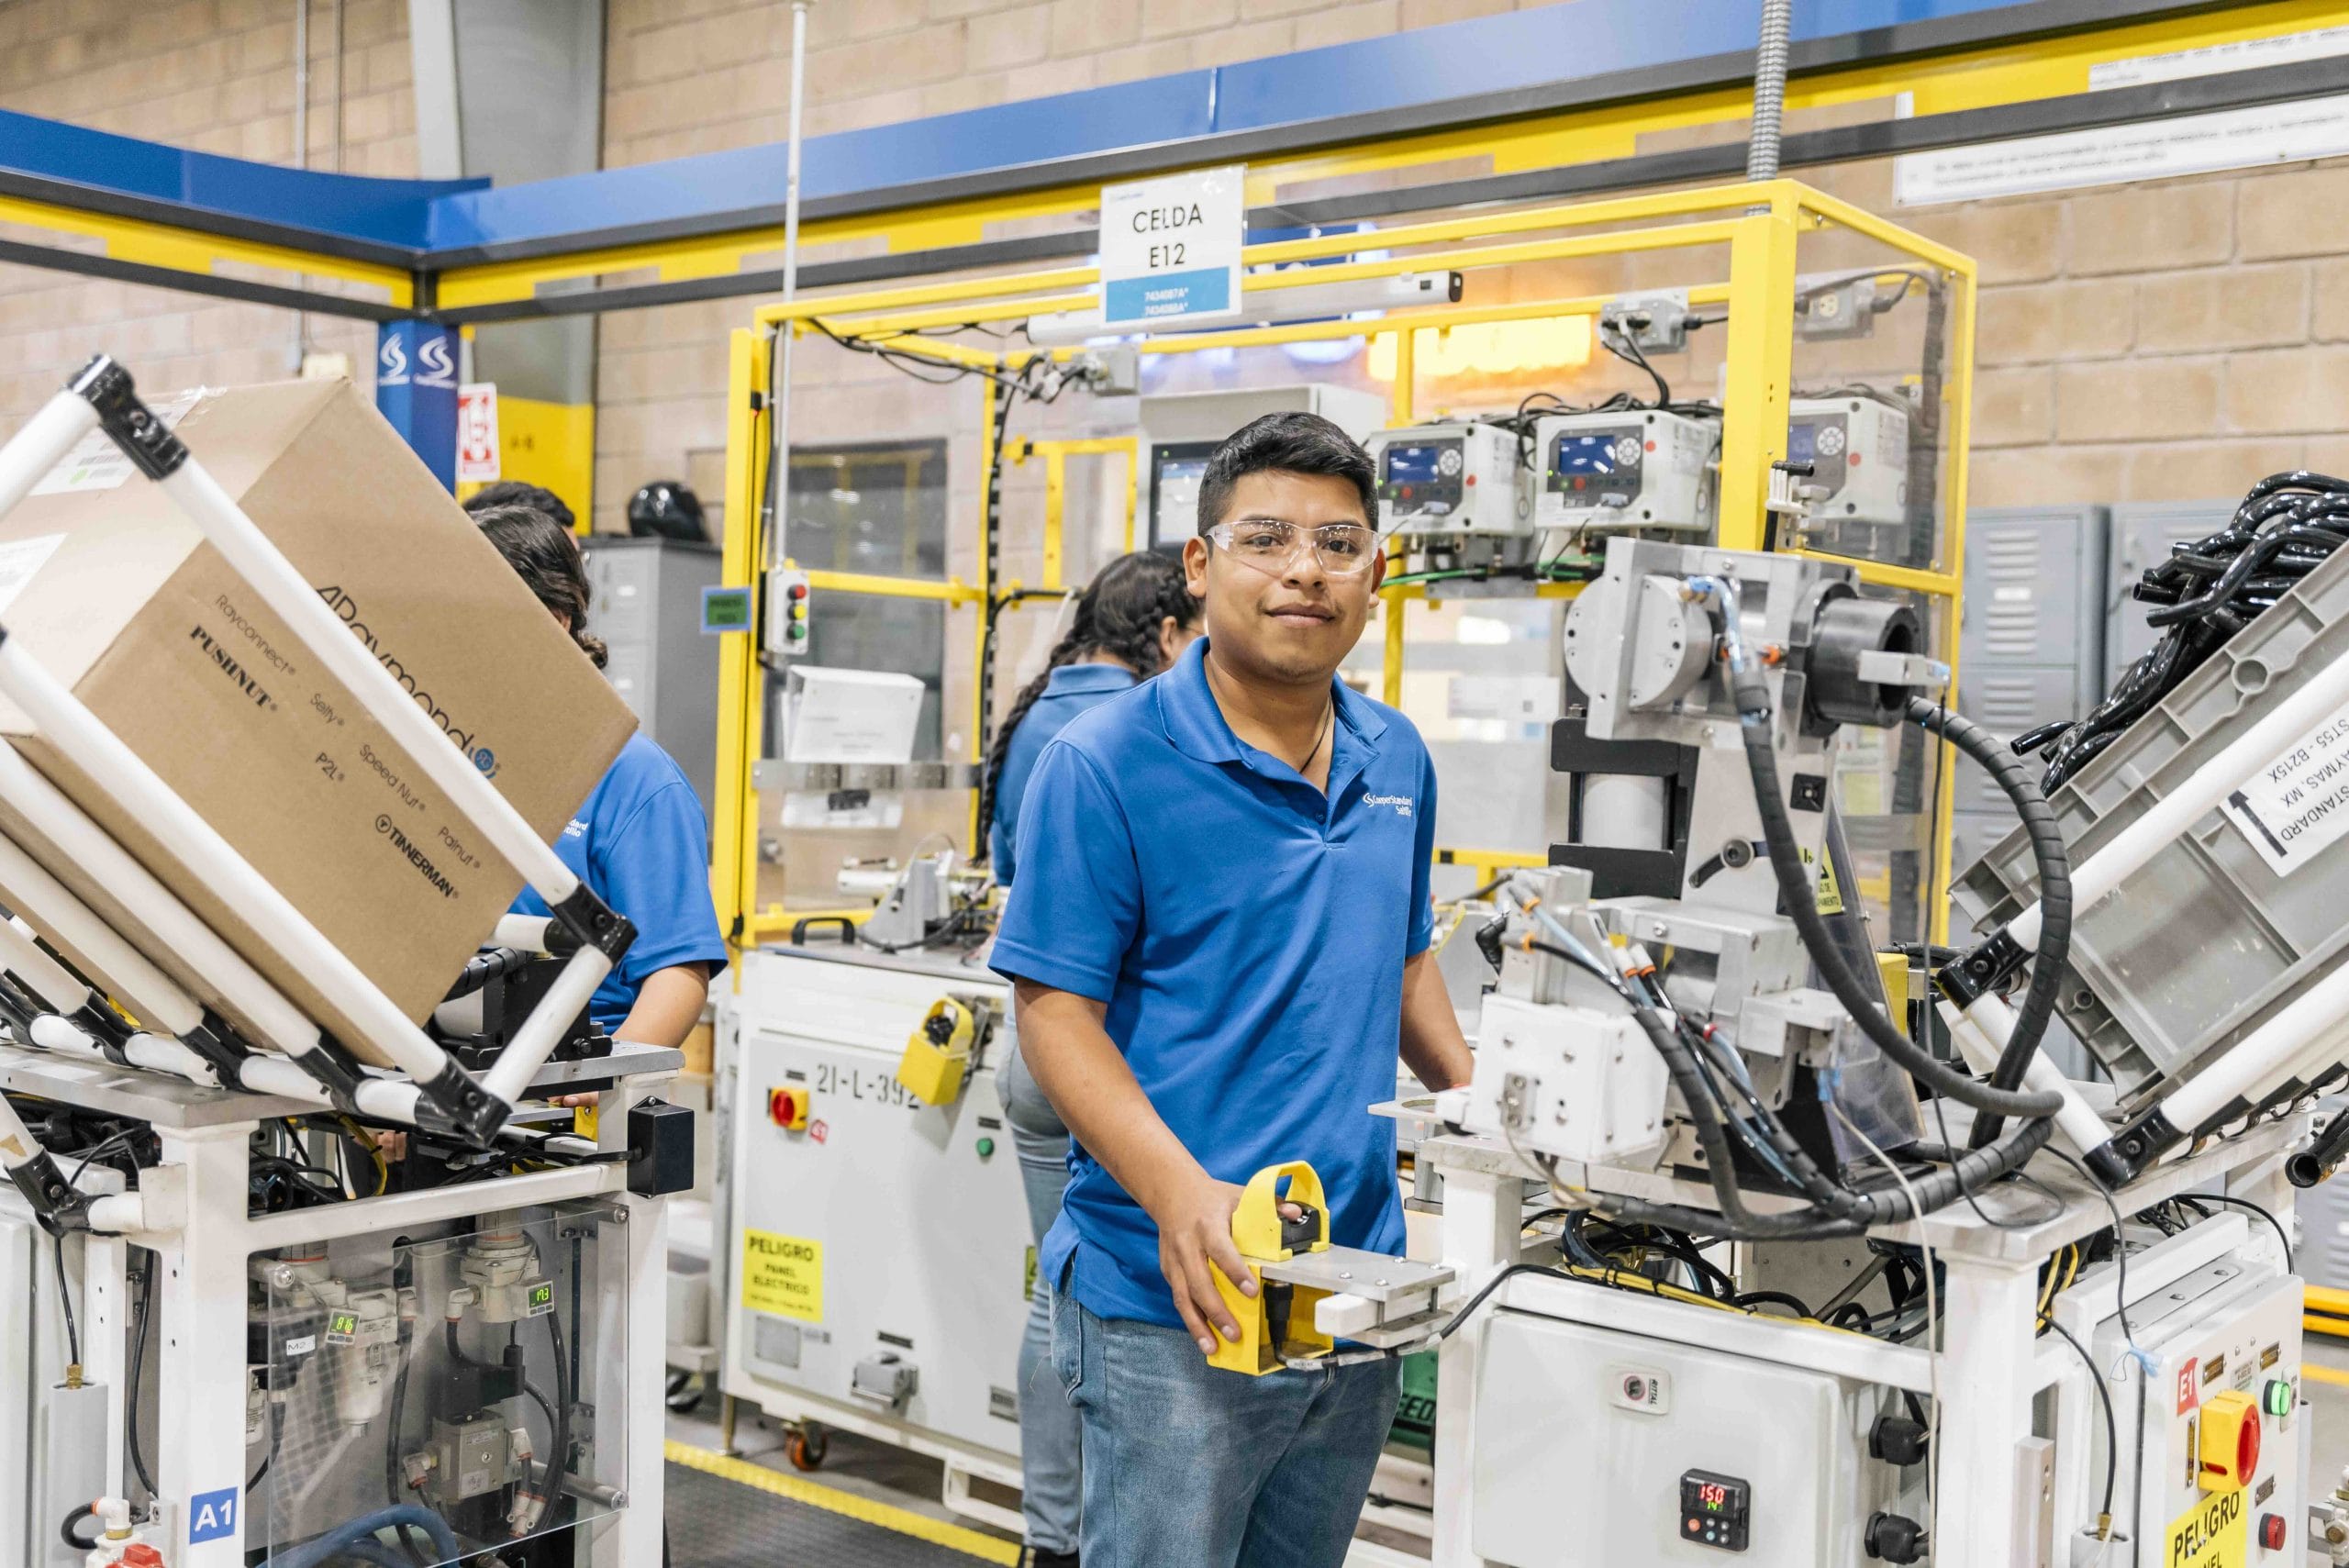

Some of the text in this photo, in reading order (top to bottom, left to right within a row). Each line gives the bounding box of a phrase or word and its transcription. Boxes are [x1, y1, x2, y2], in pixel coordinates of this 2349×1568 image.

[1132, 203, 1203, 233] CELDA
[1150, 242, 1186, 268] E12
[359, 744, 398, 787] Speed
[2267, 749, 2310, 784] B215X
[2280, 787, 2305, 808] MX
[2281, 784, 2349, 841] STANDARD
[749, 1236, 815, 1262] PELIGRO
[1650, 1378, 1659, 1405] RITTAL
[2179, 1373, 2194, 1402] E1
[1700, 1485, 1725, 1504] 150
[195, 1499, 232, 1532] A1
[2174, 1490, 2240, 1568] PELIGRO
